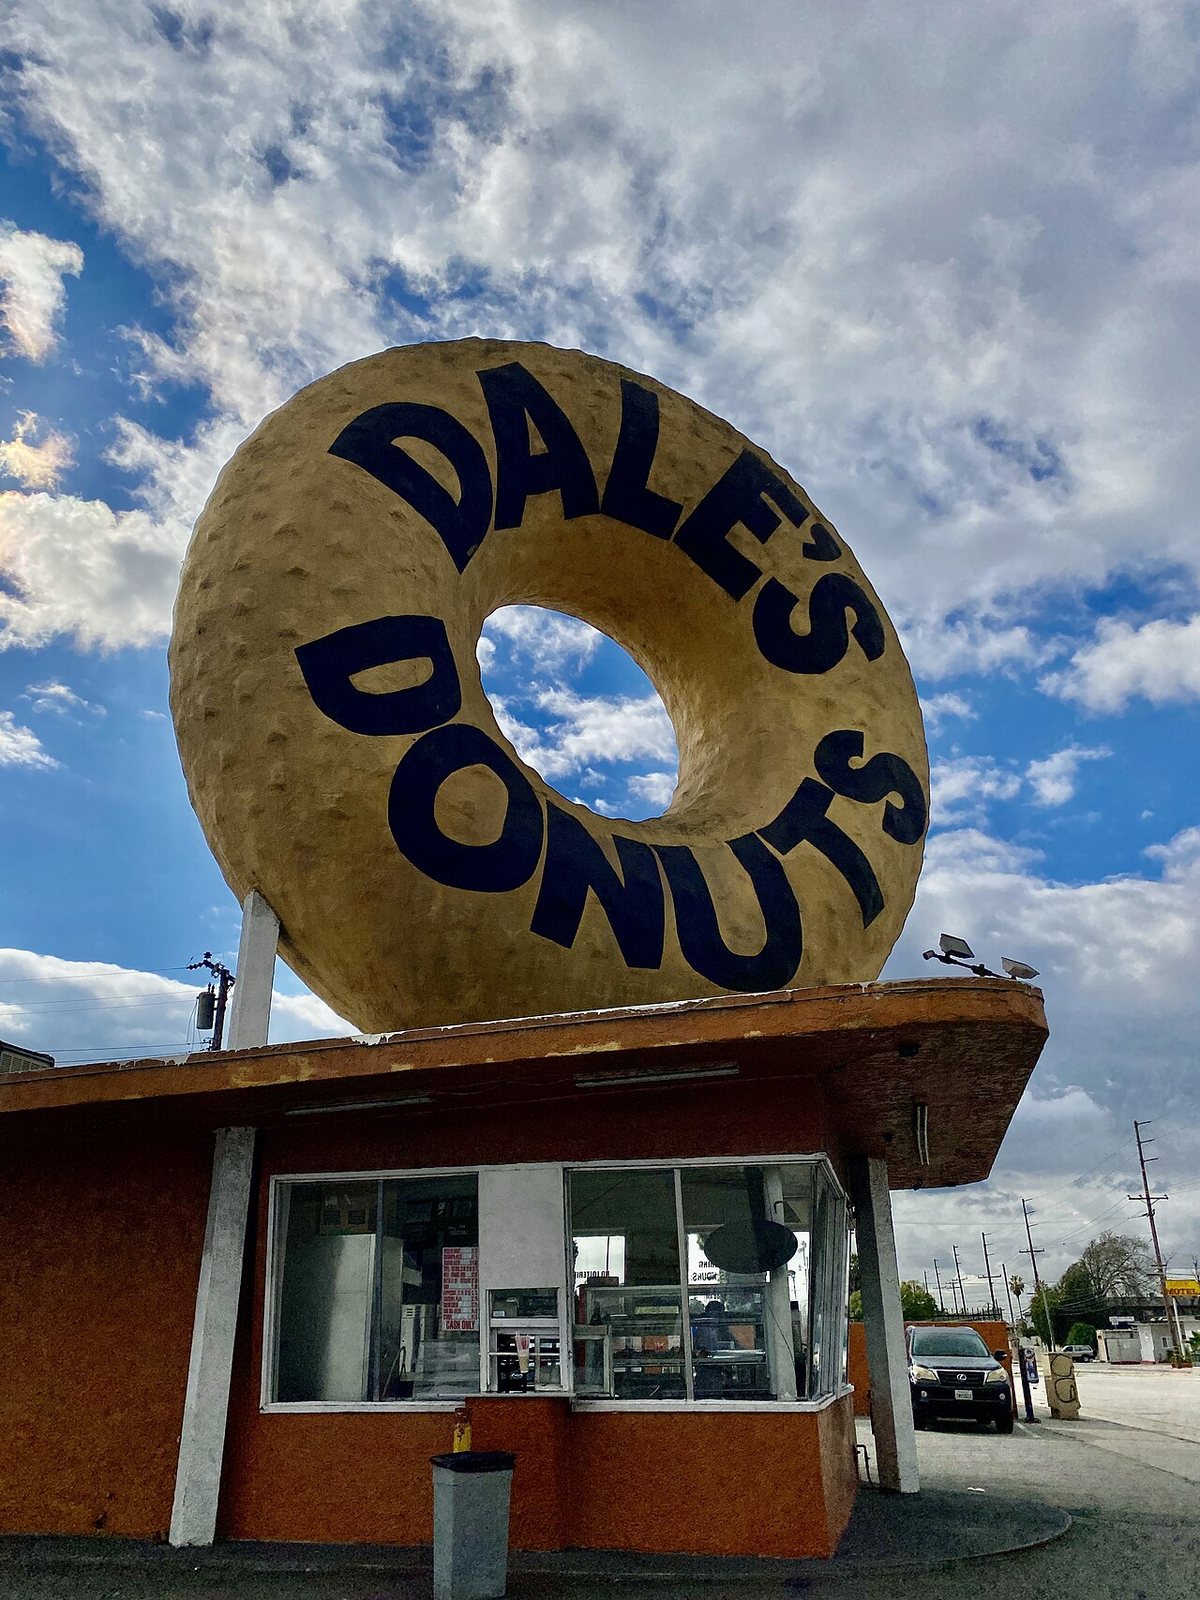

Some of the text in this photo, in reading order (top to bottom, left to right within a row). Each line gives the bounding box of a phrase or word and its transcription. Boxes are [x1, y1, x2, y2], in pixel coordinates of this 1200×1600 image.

[328, 362, 885, 674] DALE'S
[294, 615, 927, 992] DONUTS
[445, 1320, 475, 1330] CASH ONLY
